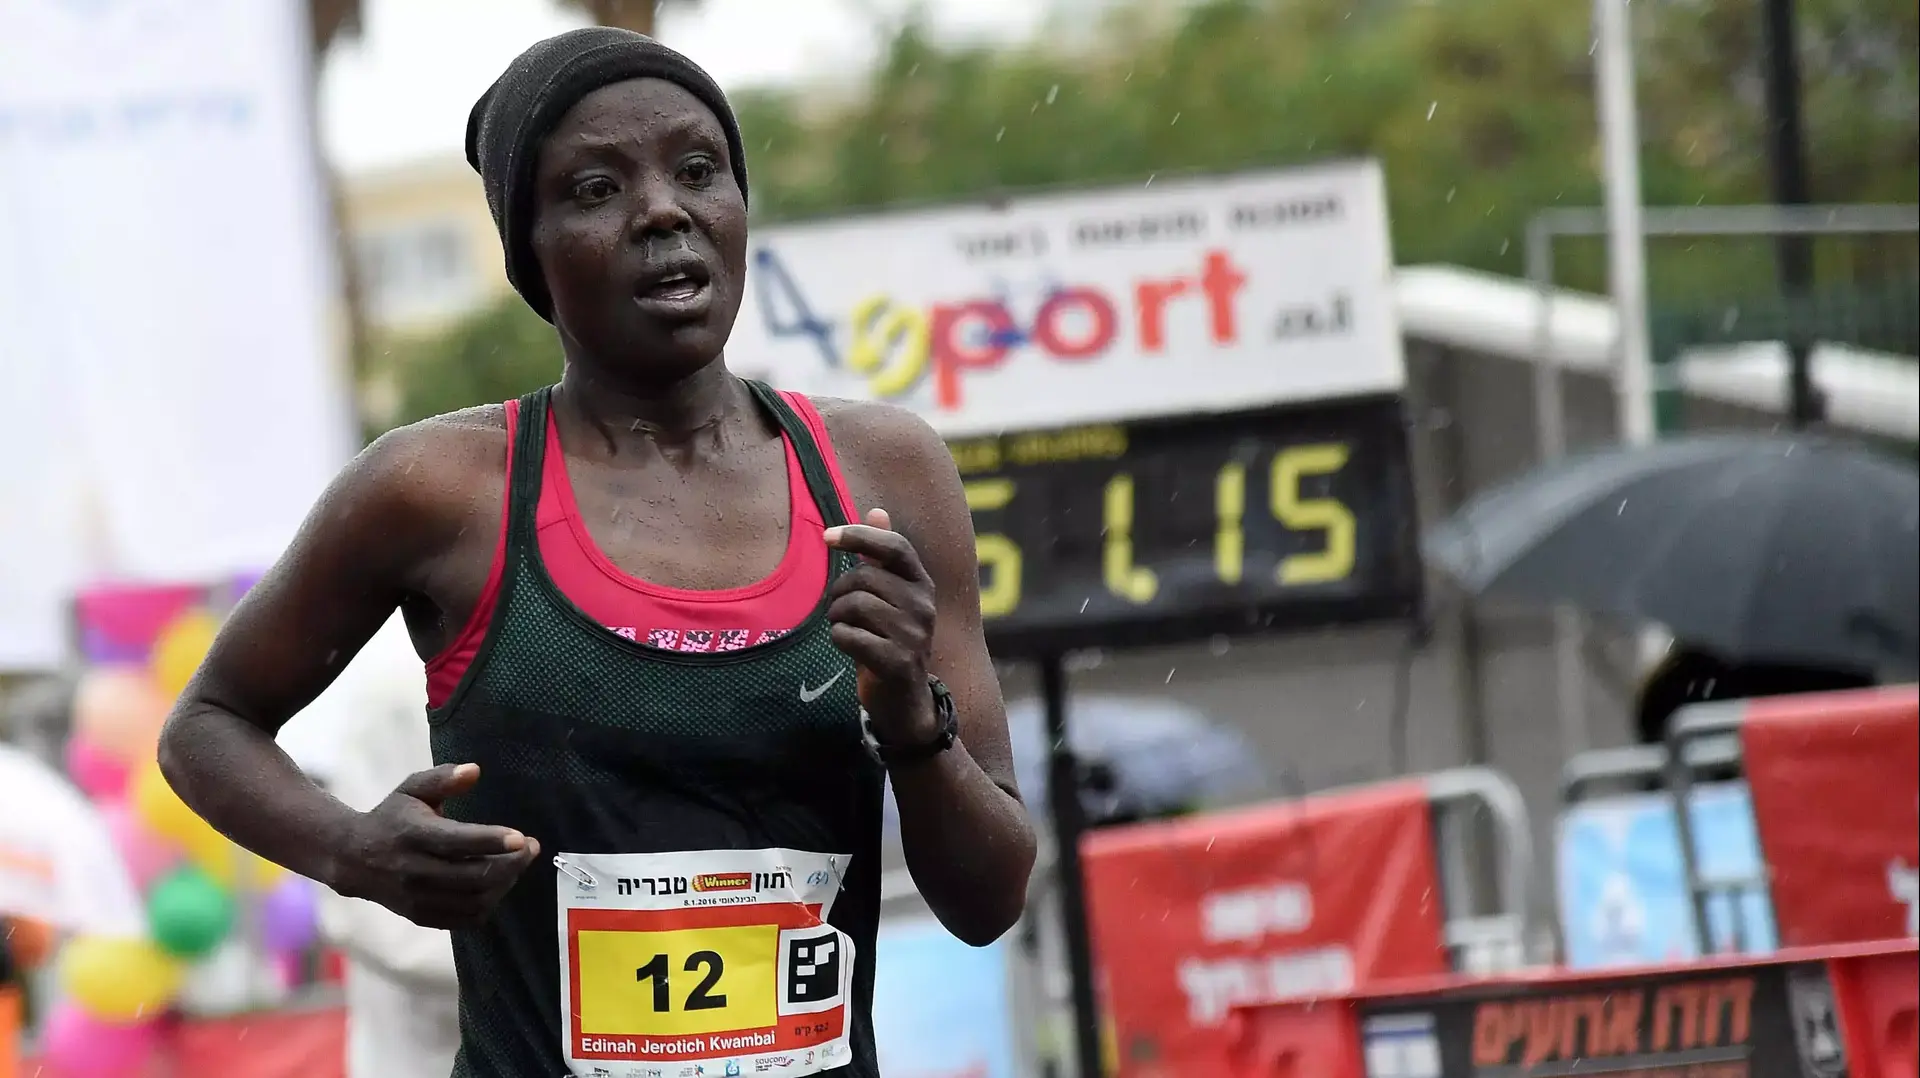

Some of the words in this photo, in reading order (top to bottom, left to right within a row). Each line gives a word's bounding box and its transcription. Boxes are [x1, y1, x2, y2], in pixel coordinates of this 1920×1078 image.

[617, 876, 687, 895] טבריה
[704, 876, 749, 888] Winner
[683, 898, 717, 907] 8.1.2016
[636, 951, 727, 1012] 12
[581, 1037, 636, 1053] Edinah
[640, 1039, 705, 1054] Jerotich
[710, 1030, 776, 1051] Kwambai
[755, 1056, 788, 1066] saucony
